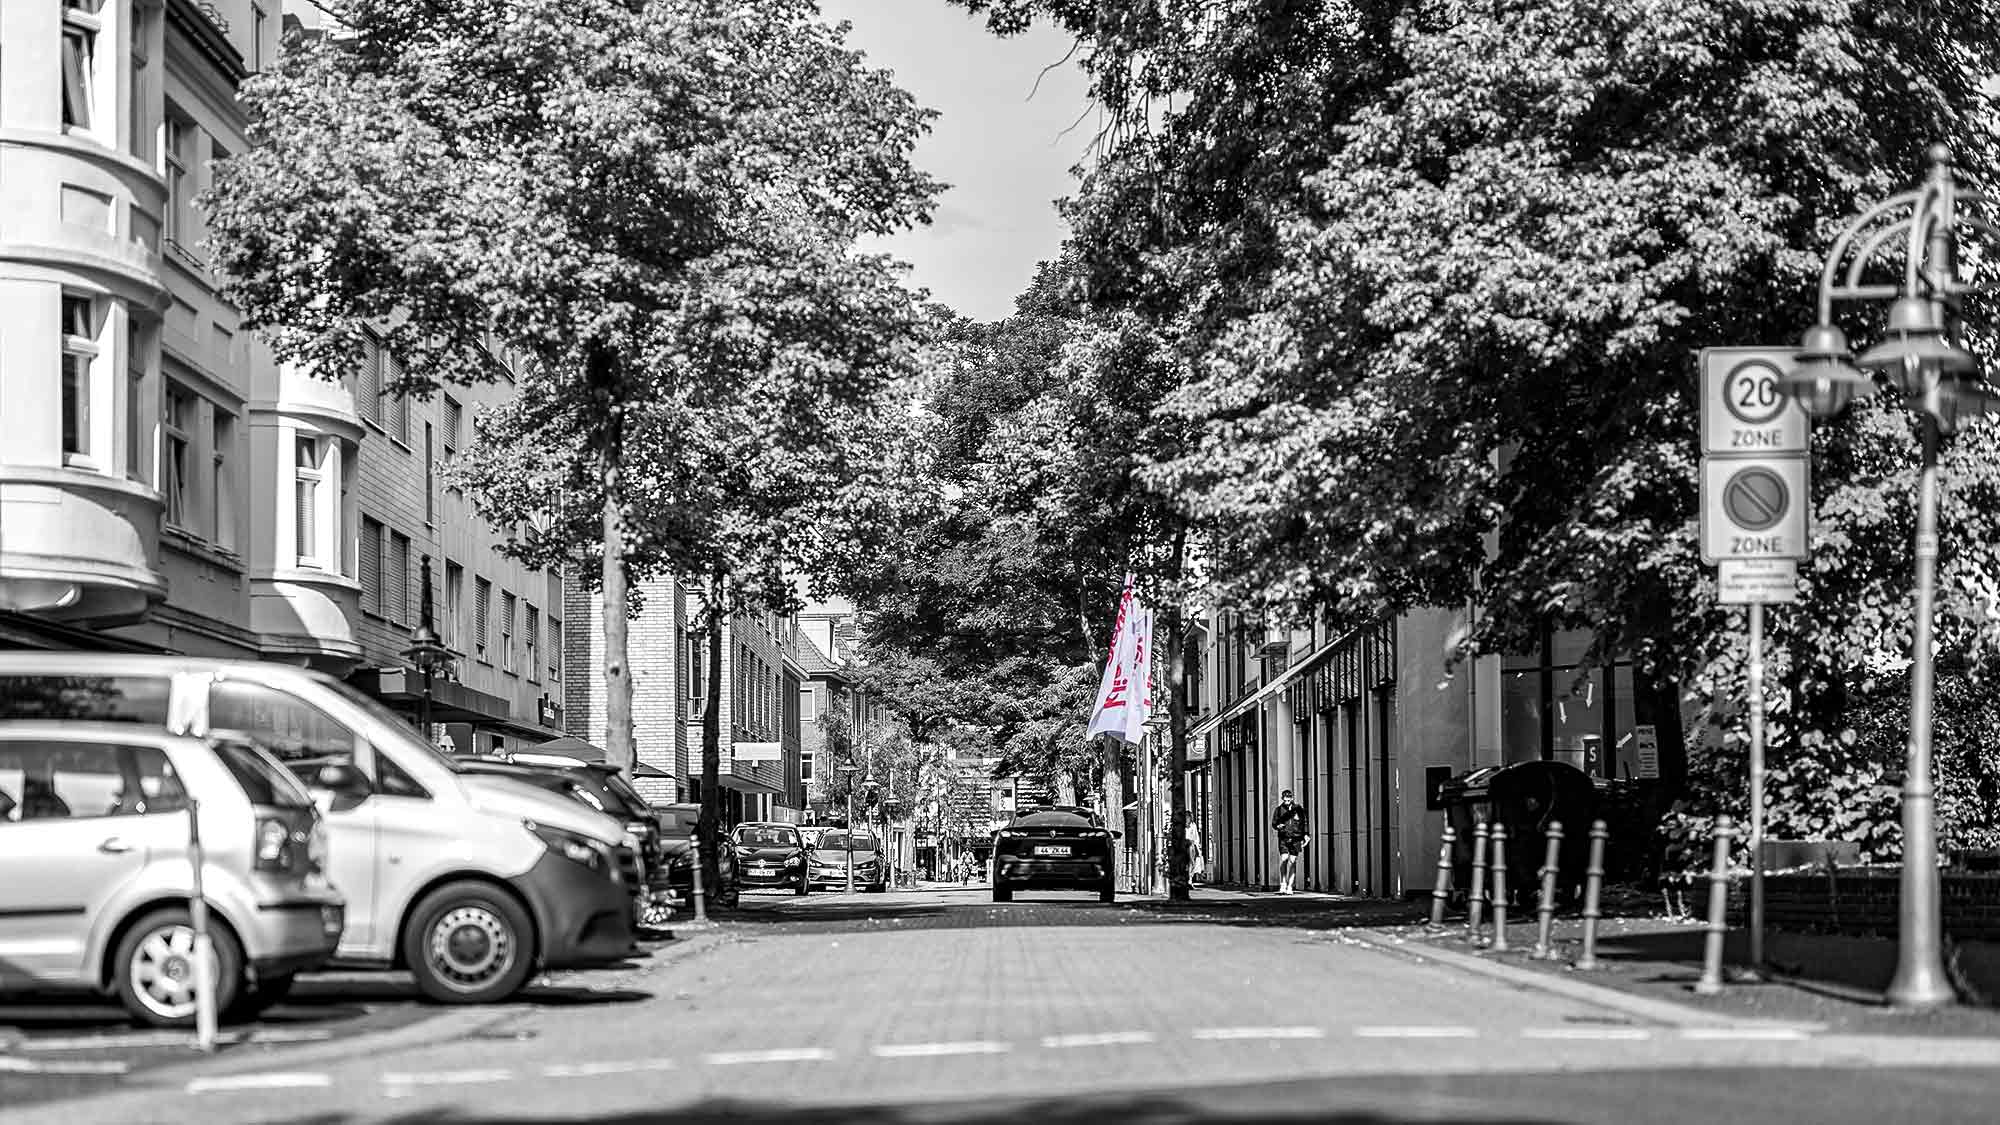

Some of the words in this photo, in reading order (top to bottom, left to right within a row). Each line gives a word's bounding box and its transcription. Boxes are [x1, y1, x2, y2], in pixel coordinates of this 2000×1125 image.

[1739, 377, 1775, 406] 20
[1731, 430, 1782, 446] ZONE
[1731, 536, 1782, 553] ZONE
